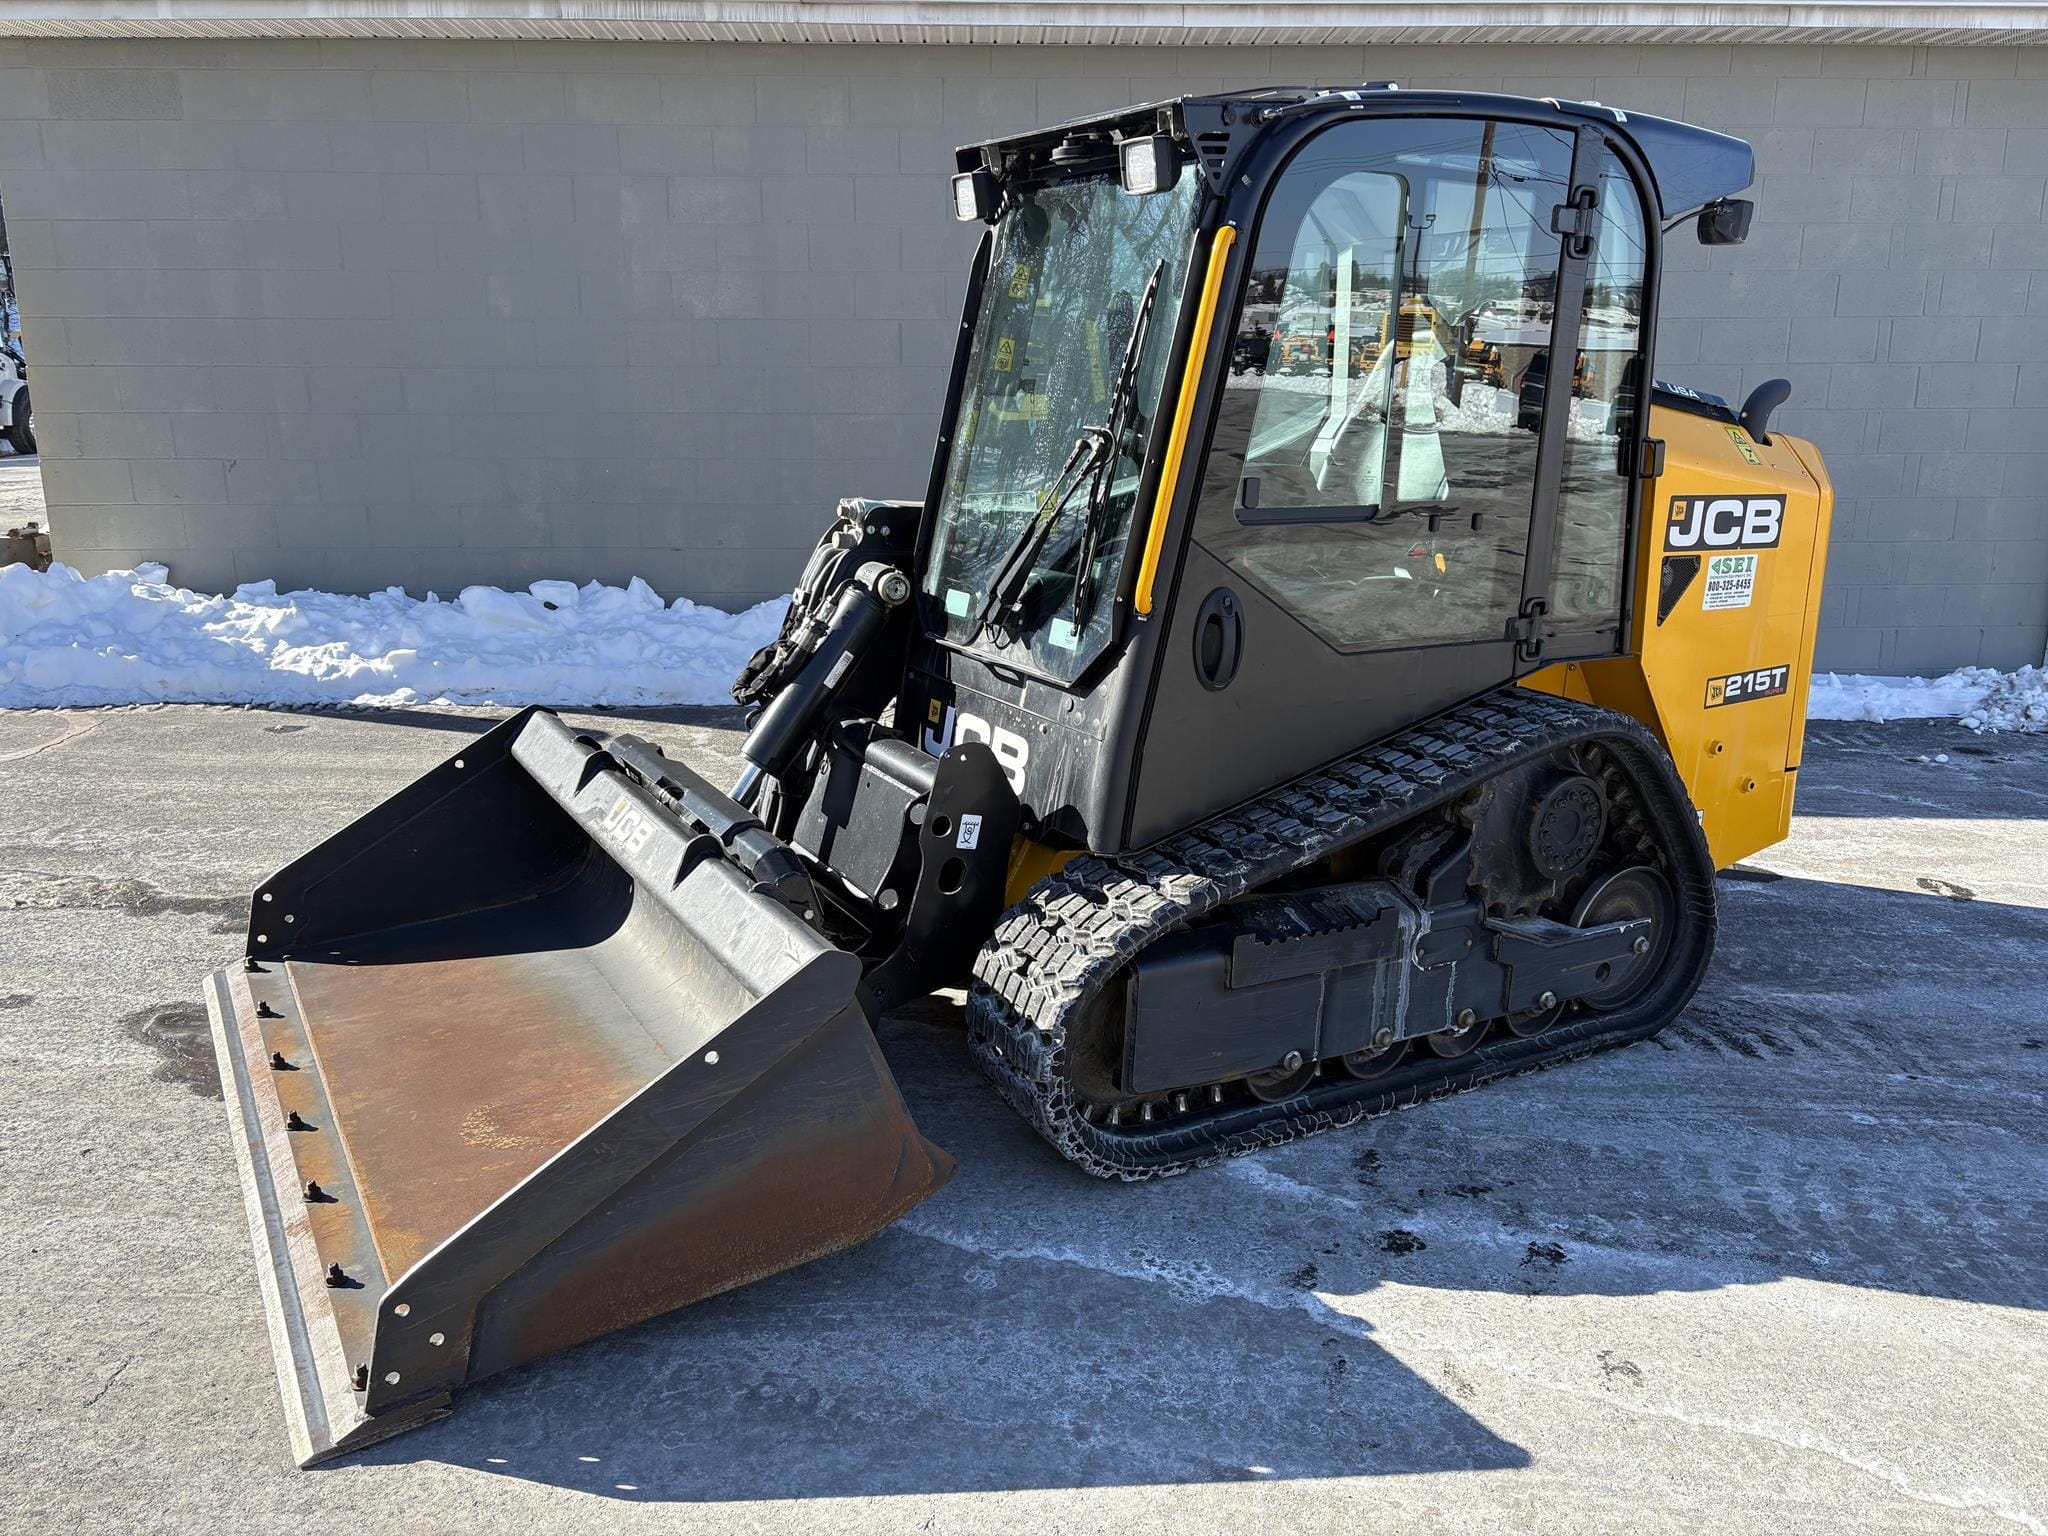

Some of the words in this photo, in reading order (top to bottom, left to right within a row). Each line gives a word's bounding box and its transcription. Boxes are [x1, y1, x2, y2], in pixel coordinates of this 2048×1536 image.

[1667, 383, 1700, 399] USA
[1669, 500, 1781, 547] JCB
[1721, 556, 1754, 574] SEI
[1726, 667, 1787, 697] 215T
[604, 802, 656, 859] JCB
